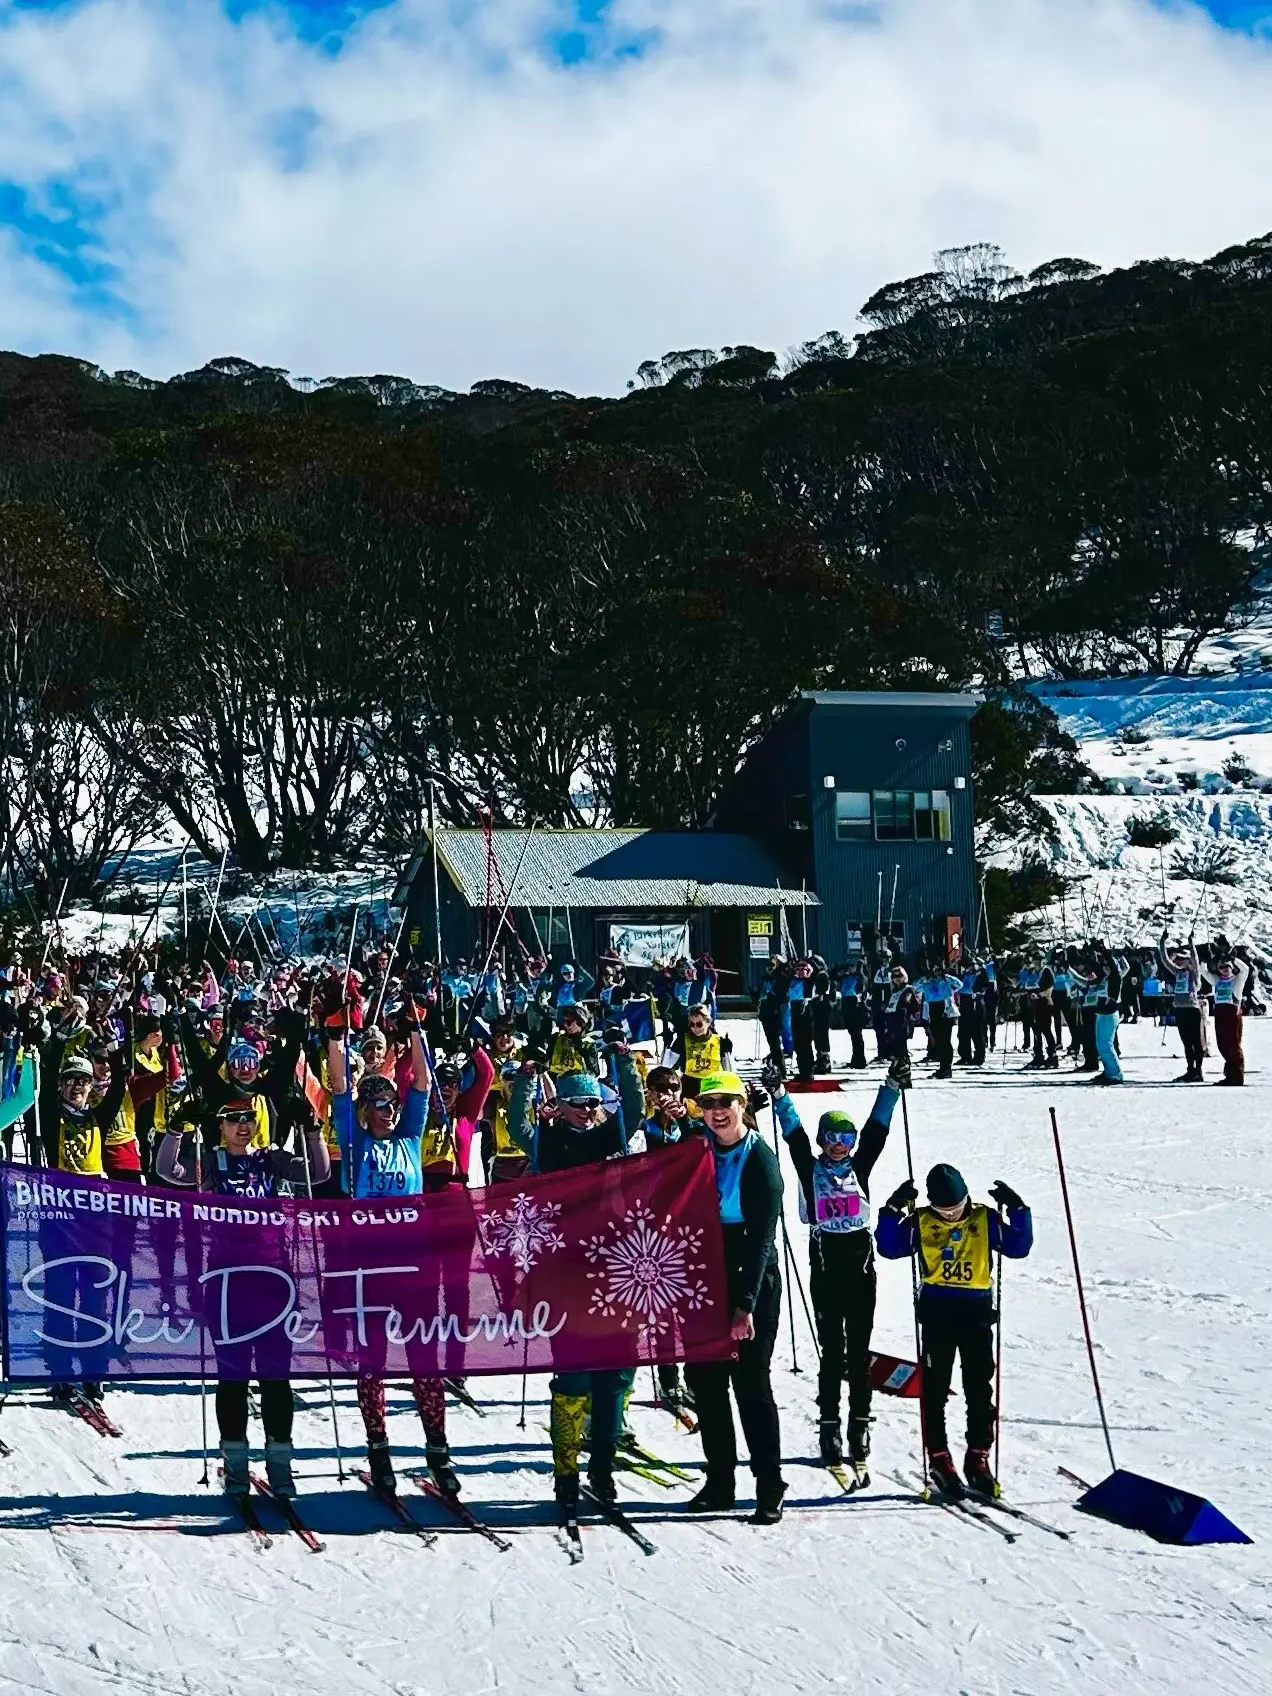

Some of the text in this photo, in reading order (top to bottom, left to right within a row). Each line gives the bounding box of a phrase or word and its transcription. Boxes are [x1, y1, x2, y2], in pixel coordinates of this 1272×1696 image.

[368, 1171, 406, 1191] 1379
[15, 1180, 419, 1226] BIRKEBEINER NORDIC SKI CLUB
[942, 1261, 973, 1281] 845
[21, 1255, 568, 1348] Ski De Femme
